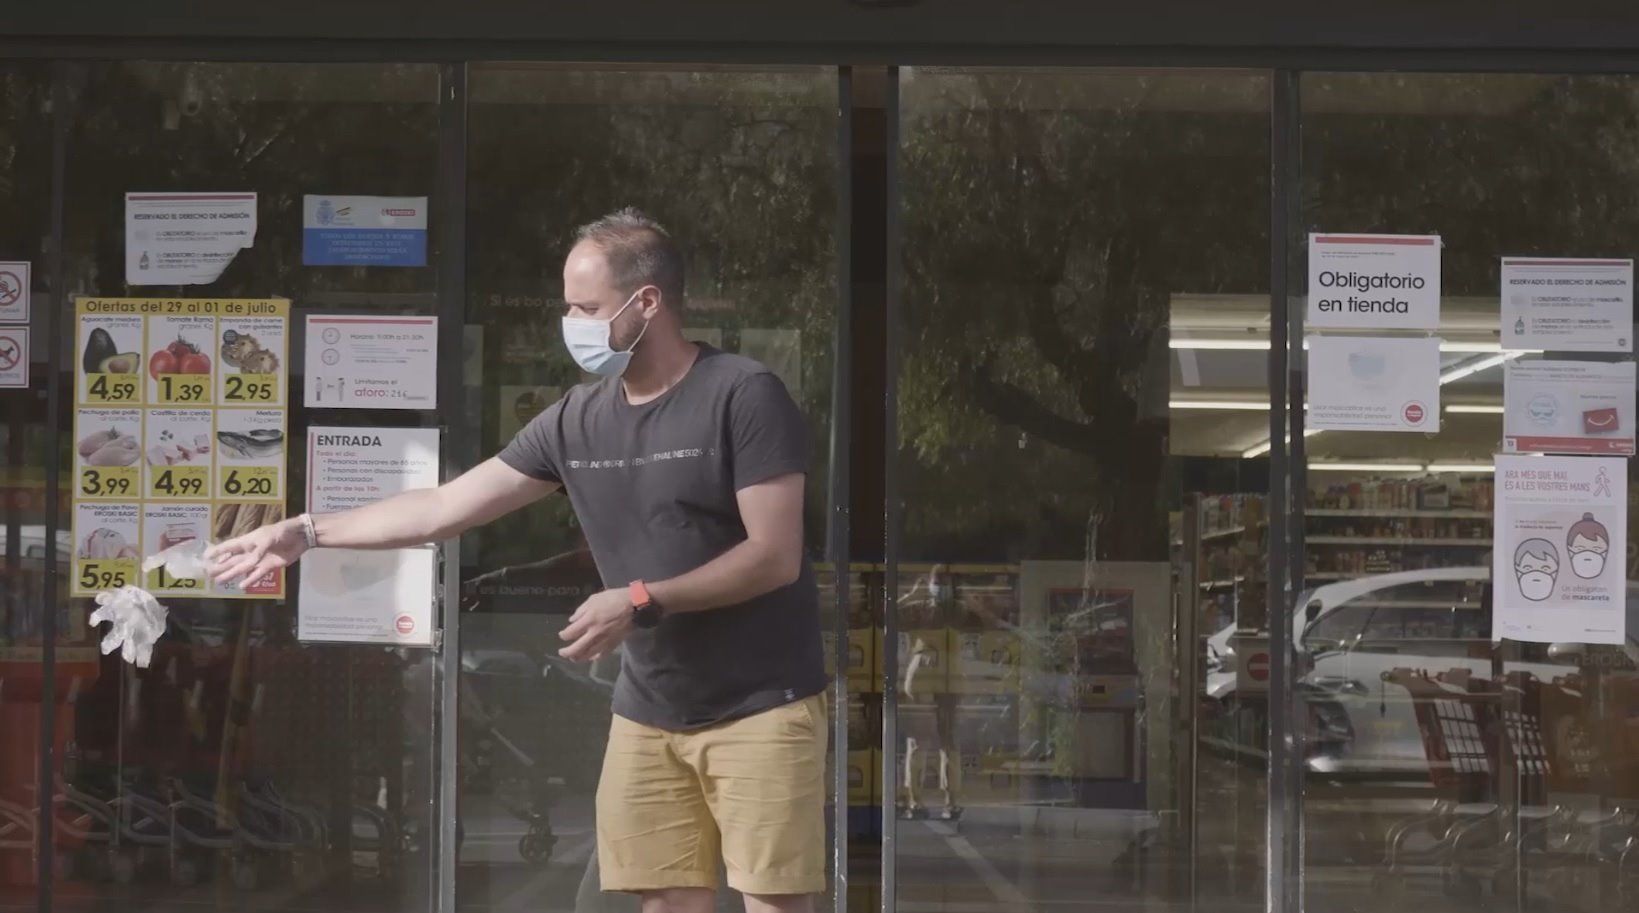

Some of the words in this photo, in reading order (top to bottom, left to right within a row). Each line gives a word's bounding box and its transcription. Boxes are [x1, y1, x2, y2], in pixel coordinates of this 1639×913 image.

[1319, 271, 1425, 293] Obligatorio
[86, 301, 136, 312] Ofertas
[140, 301, 162, 312] del
[167, 301, 182, 312] 29
[188, 302, 200, 313] al
[204, 302, 219, 313] 01
[225, 302, 243, 313] de
[247, 302, 276, 315] julio
[1318, 299, 1342, 312] en
[1347, 297, 1408, 313] tienda
[89, 375, 135, 401] 4,59
[161, 376, 203, 402] 1,39
[225, 376, 271, 400] 2,95
[317, 435, 382, 447] ENTRADA
[82, 470, 130, 496] 3,99
[155, 470, 202, 496] 4,99
[224, 470, 272, 496] 6,20
[1504, 470, 1519, 479] ARA
[1537, 470, 1553, 480] QUE
[1522, 481, 1536, 490] LES
[1537, 482, 1568, 491] VOSTRES
[1569, 482, 1591, 492] MANS
[81, 564, 125, 590] 5,95
